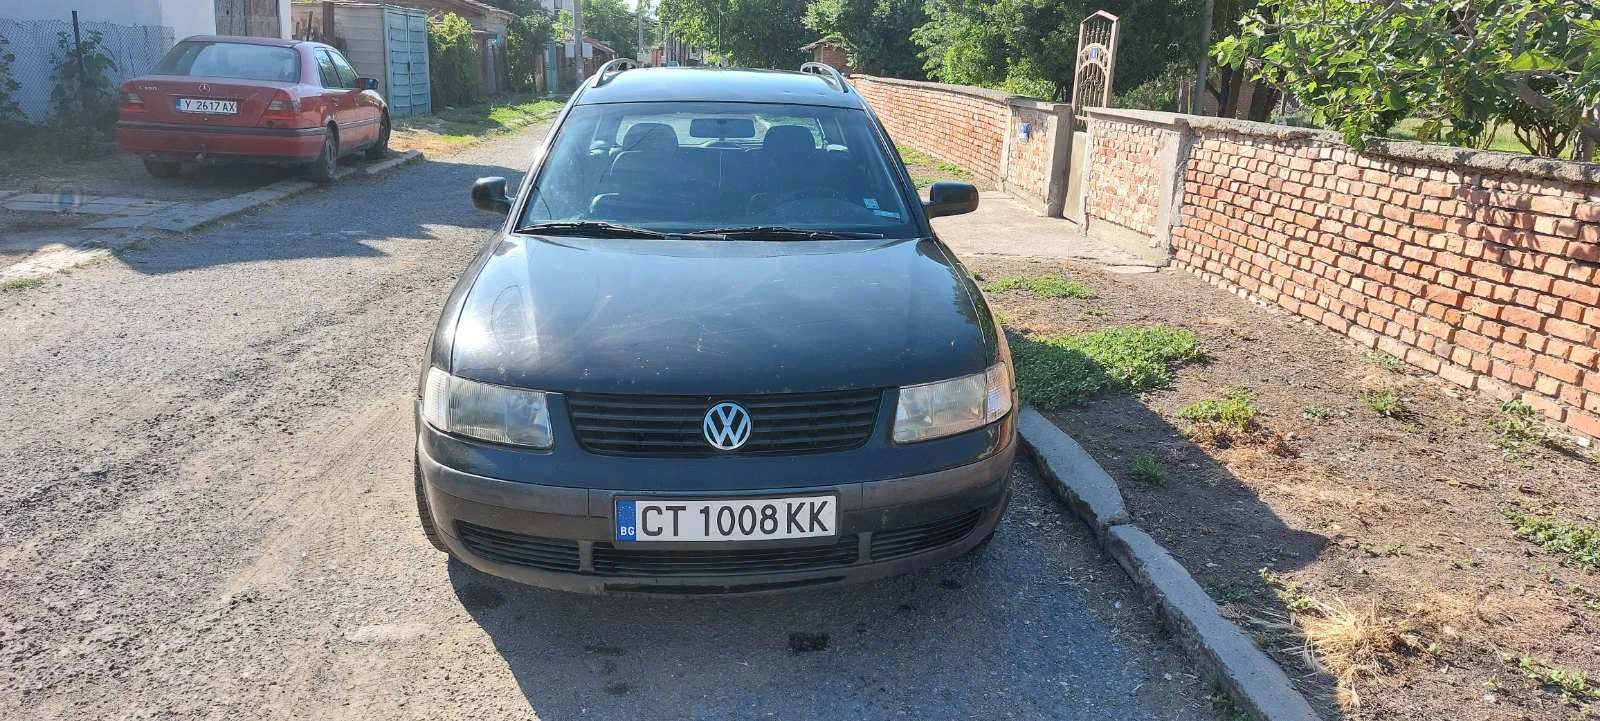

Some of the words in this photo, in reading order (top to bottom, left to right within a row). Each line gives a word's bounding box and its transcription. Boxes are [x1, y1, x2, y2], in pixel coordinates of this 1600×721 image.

[196, 101, 221, 111] 2617
[222, 102, 235, 112] AX
[704, 403, 751, 450] VW
[641, 505, 686, 537] CT
[700, 504, 779, 537] 1008
[786, 501, 829, 534] KK
[620, 526, 635, 536] BG
